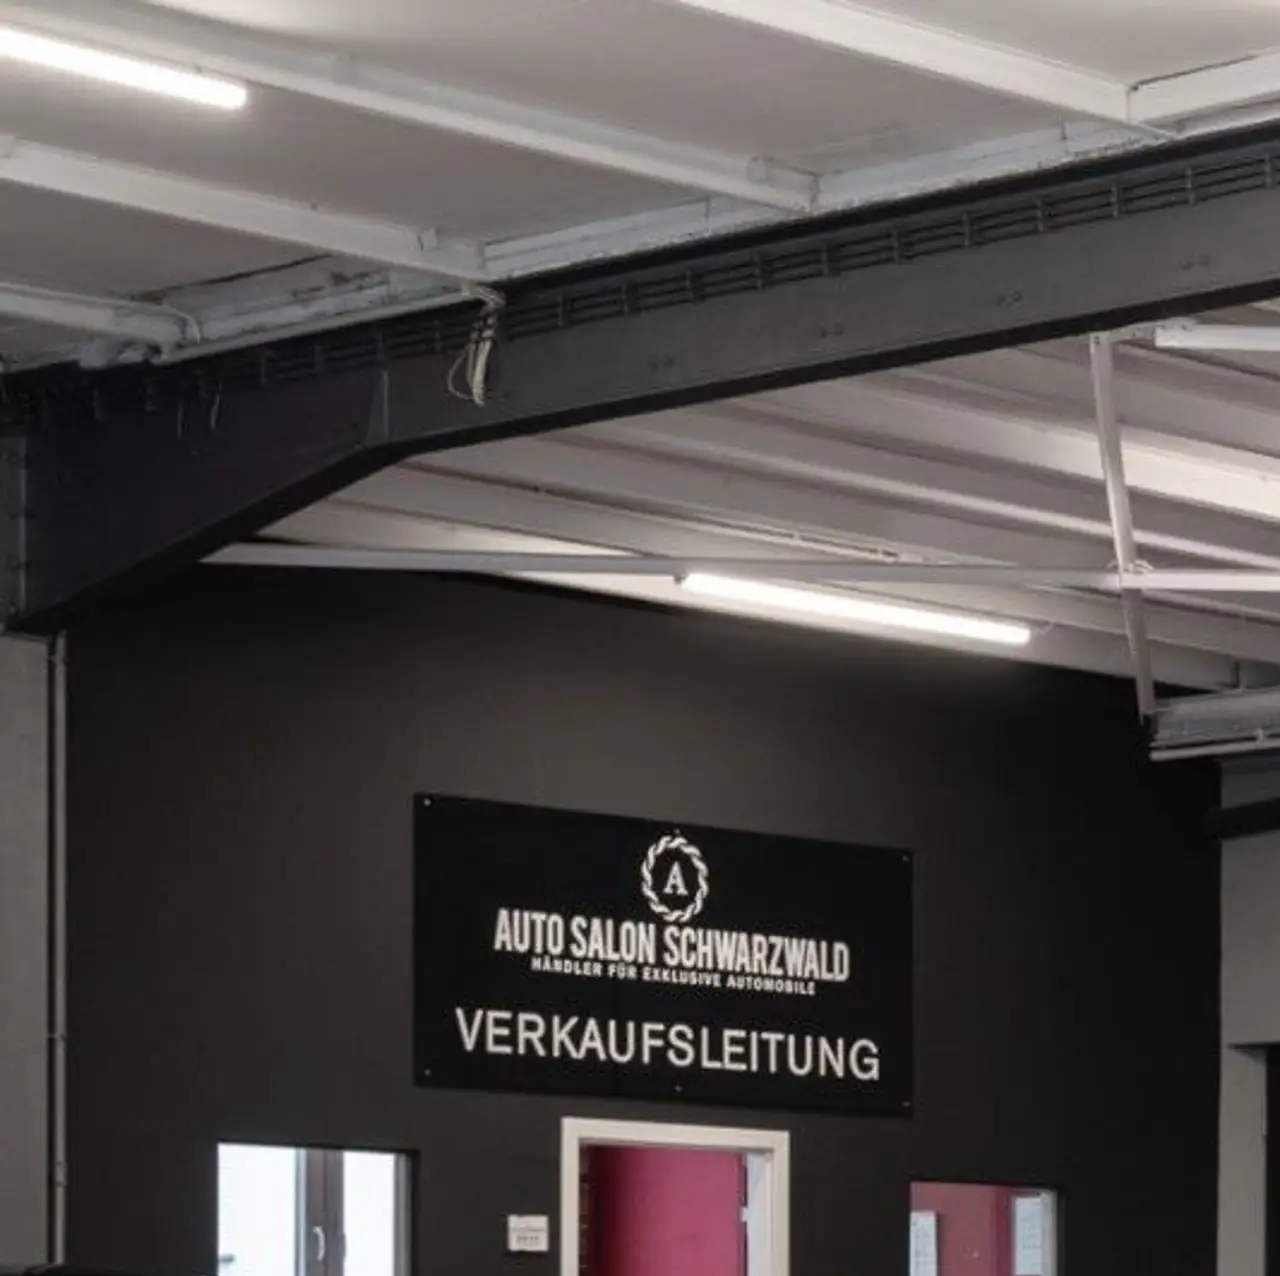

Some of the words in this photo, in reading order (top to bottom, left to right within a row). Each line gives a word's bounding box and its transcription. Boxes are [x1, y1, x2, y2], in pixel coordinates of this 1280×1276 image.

[493, 907, 565, 956] AUTO
[570, 914, 656, 965] SALON
[662, 924, 850, 982] SCHWARZWALD
[531, 956, 602, 978] HÄNDLER
[607, 963, 638, 981] FÜR
[642, 967, 722, 988] EXKLUSIVE
[726, 975, 817, 996] AUTOMOBILE
[455, 1006, 880, 1081] VERKAUFSLEITUNG
